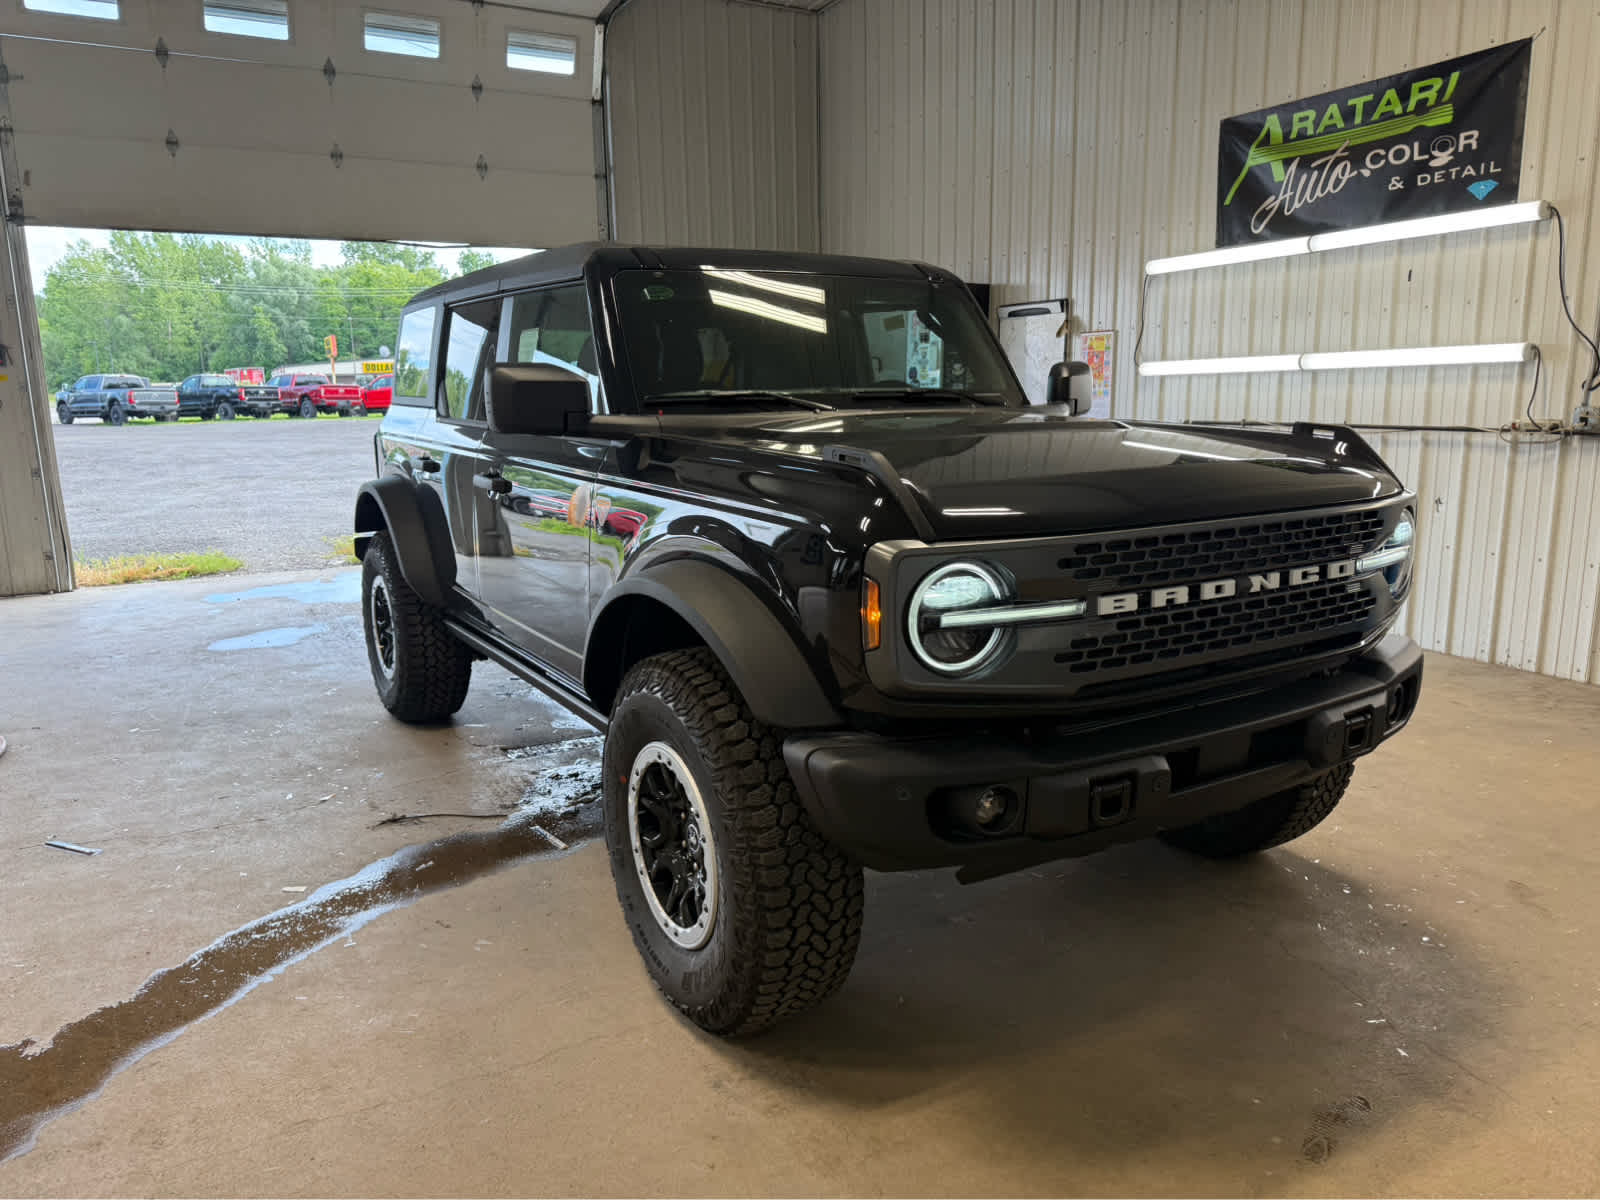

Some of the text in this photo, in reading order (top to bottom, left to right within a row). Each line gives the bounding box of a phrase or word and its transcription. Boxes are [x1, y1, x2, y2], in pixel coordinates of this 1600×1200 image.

[1223, 71, 1461, 206] ARATARI
[1388, 160, 1502, 192] & DETAIL
[1250, 129, 1480, 235] Auto COLOR
[1096, 558, 1357, 617] BRONCO
